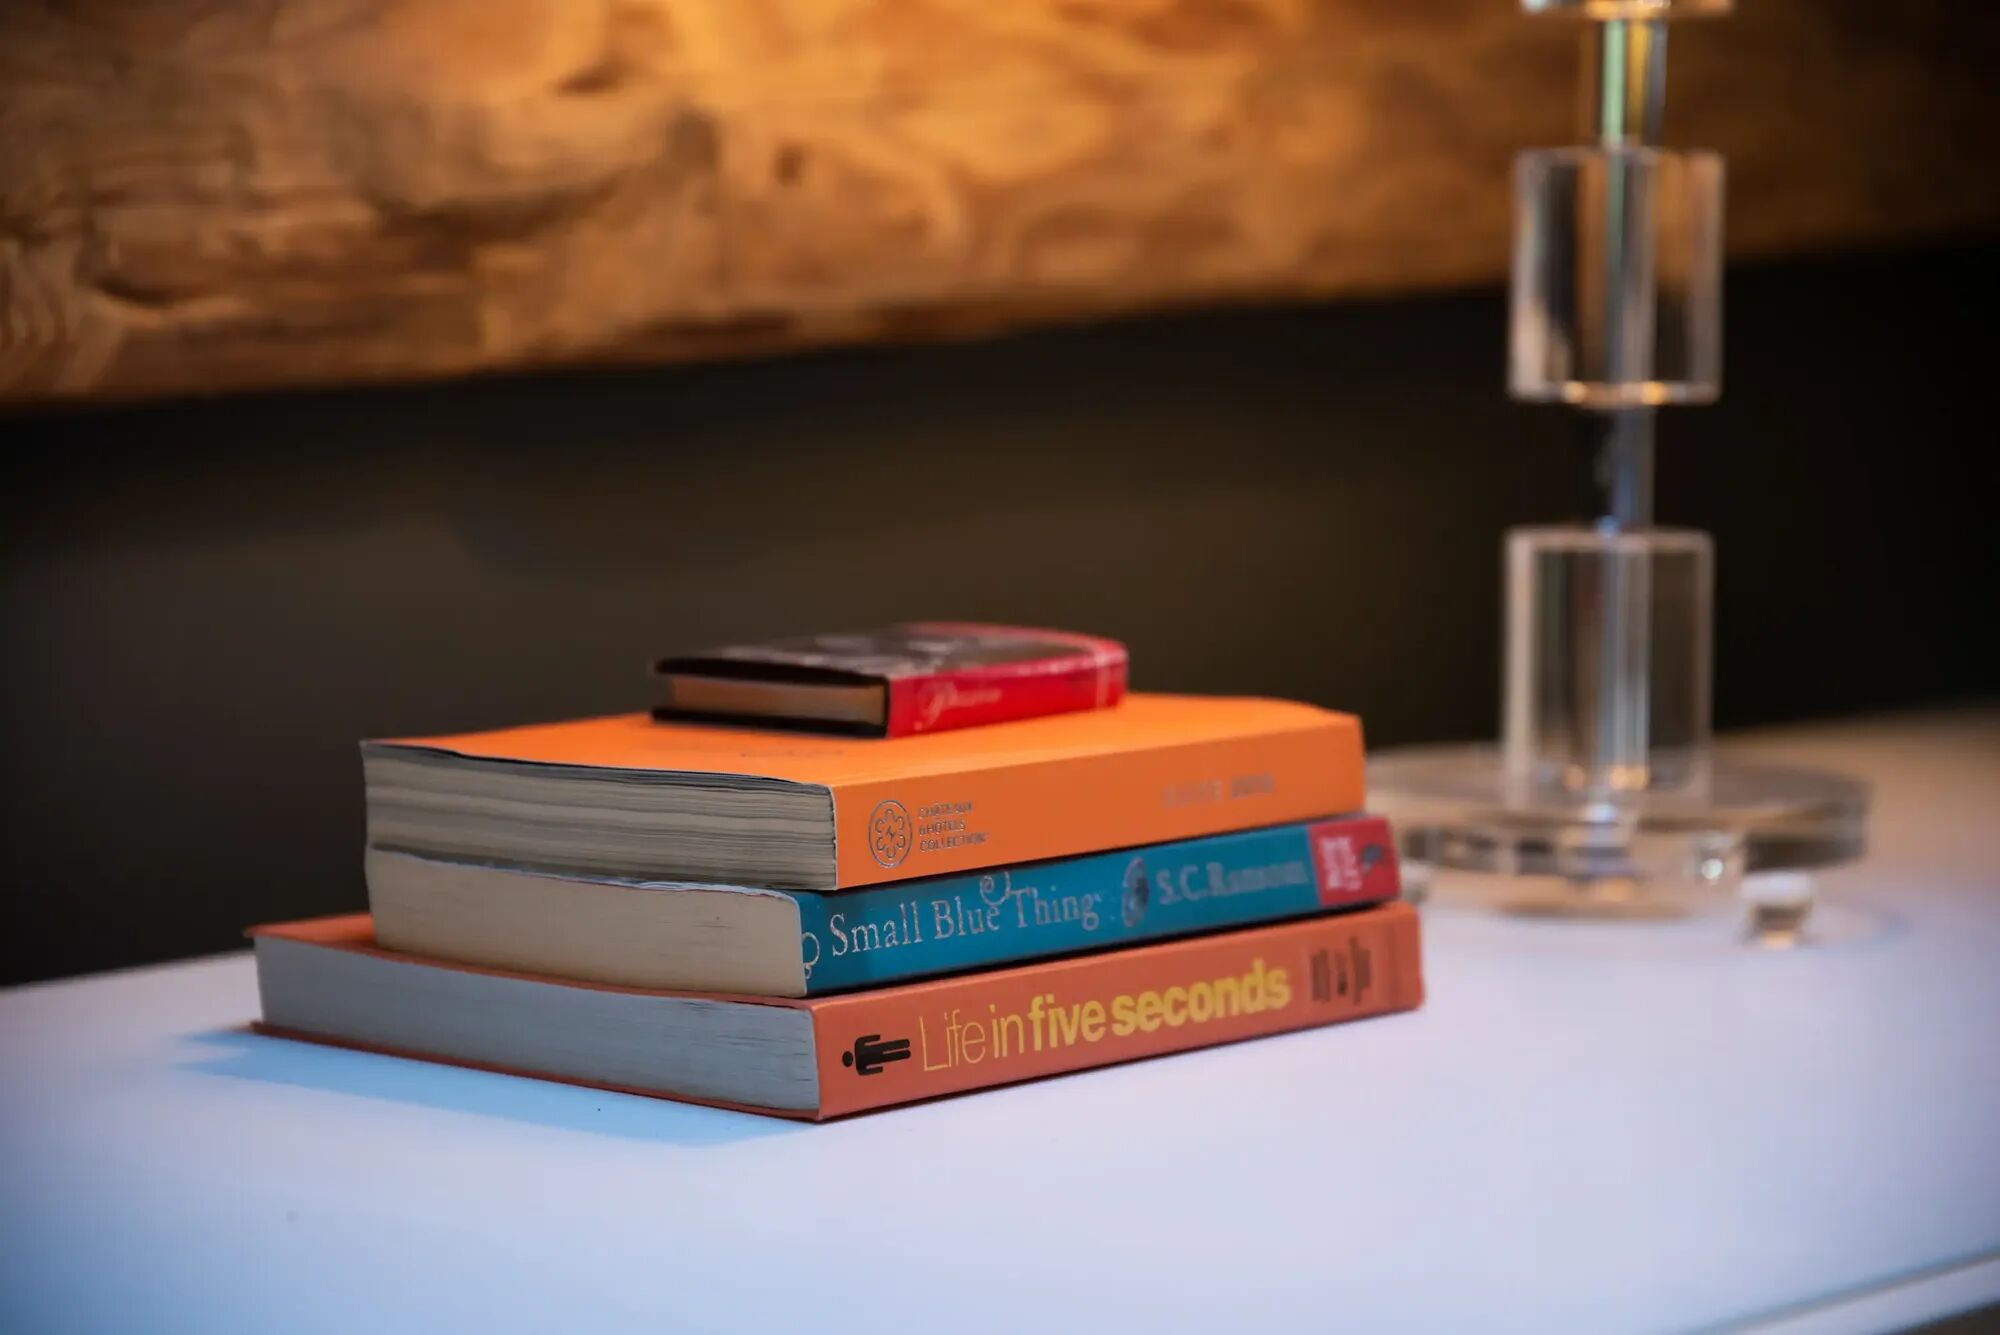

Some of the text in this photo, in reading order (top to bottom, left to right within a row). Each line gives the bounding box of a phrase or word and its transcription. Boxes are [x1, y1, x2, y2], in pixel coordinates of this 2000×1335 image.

[830, 879, 1101, 957] Small Blue Thing
[919, 1009, 987, 1072] Life
[988, 1003, 1026, 1060] in
[1028, 993, 1107, 1052] five
[1111, 956, 1293, 1037] seconds
